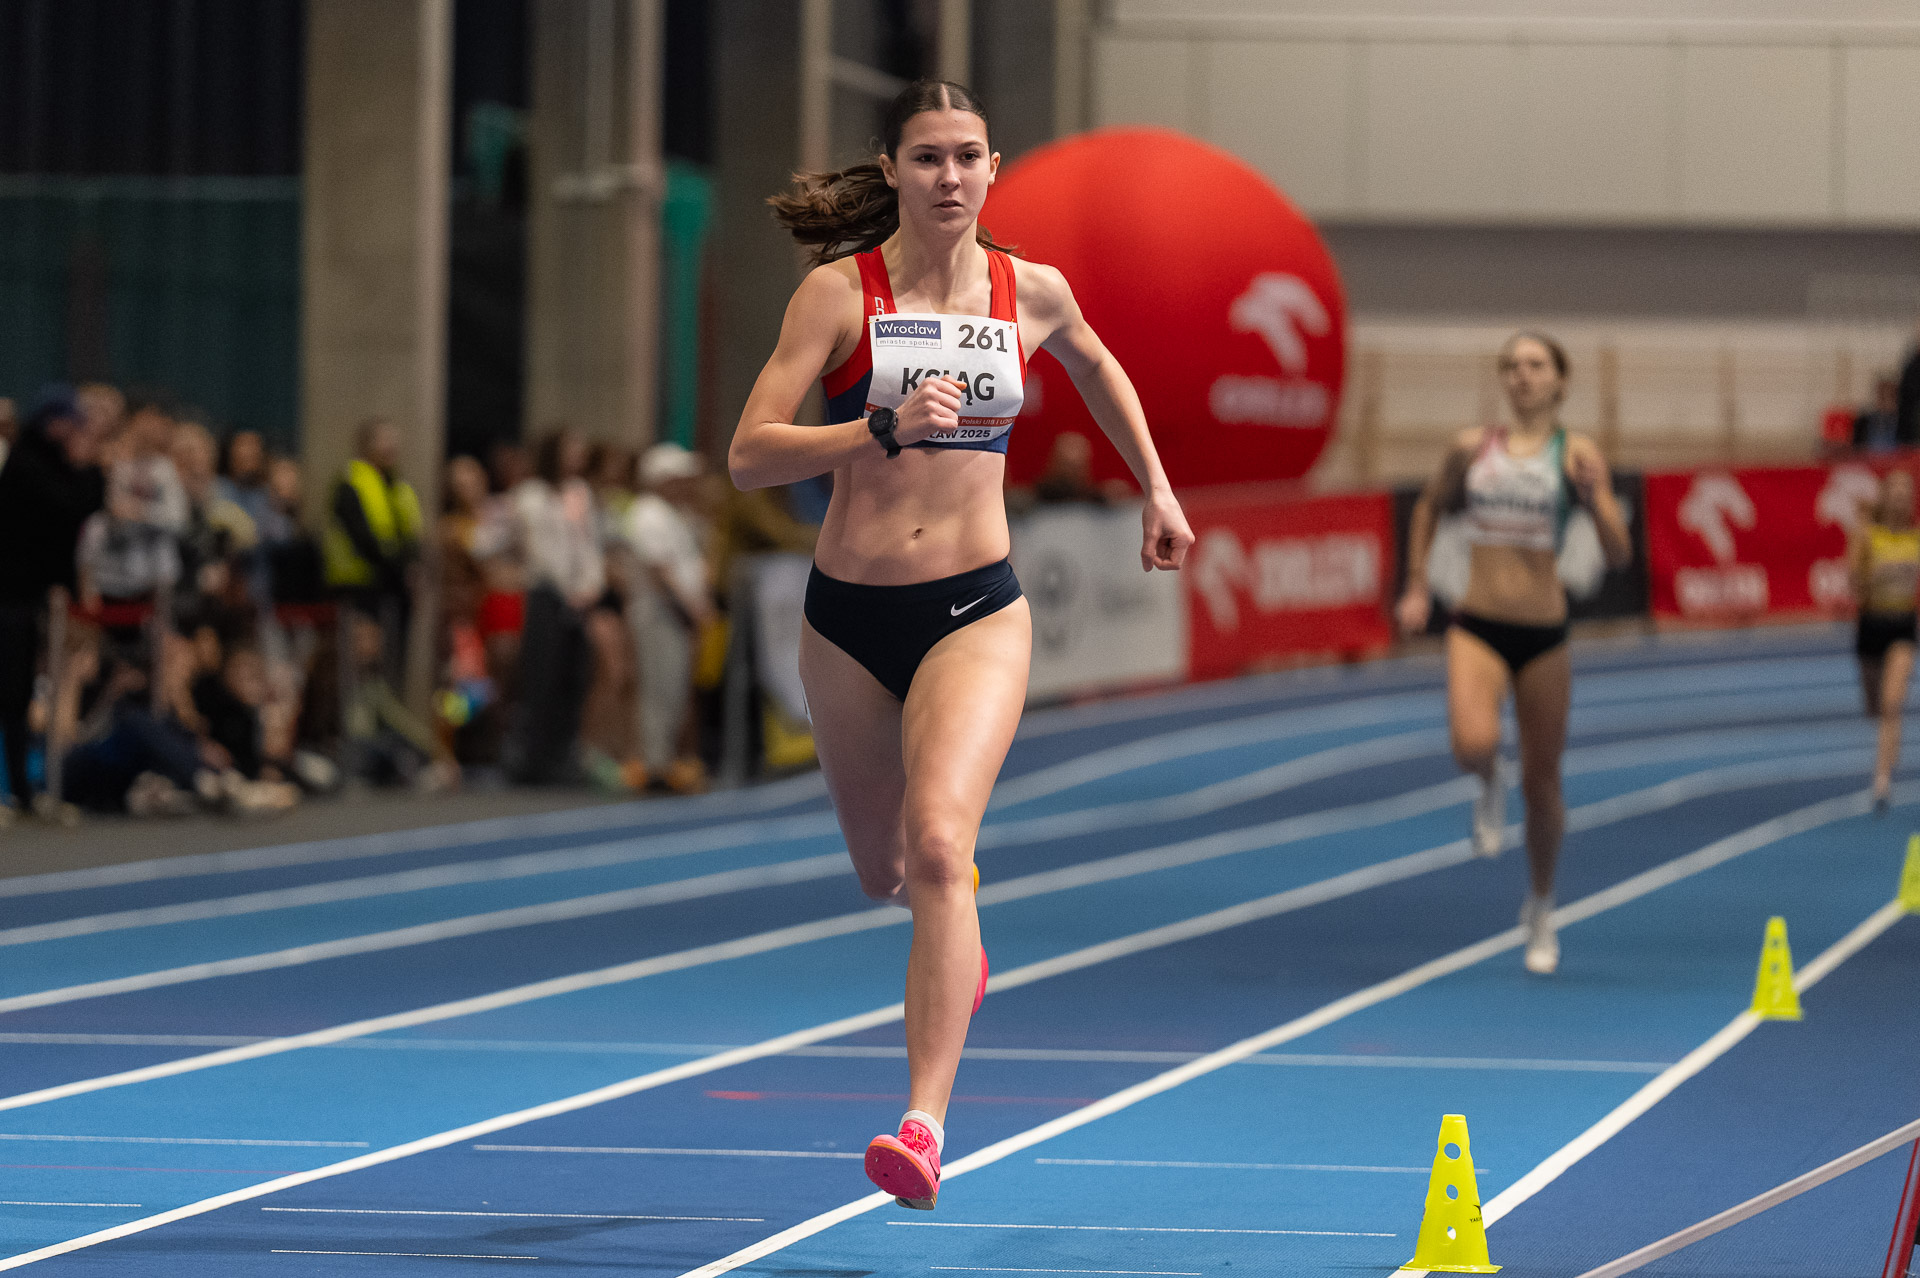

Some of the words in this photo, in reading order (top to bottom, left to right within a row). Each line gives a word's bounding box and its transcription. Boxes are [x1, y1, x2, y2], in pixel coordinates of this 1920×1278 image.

[878, 322, 938, 335] Wrocław
[909, 339, 939, 347] spotkań
[958, 324, 1008, 353] 261
[901, 367, 995, 406] KĄG
[960, 429, 991, 438] 2025
